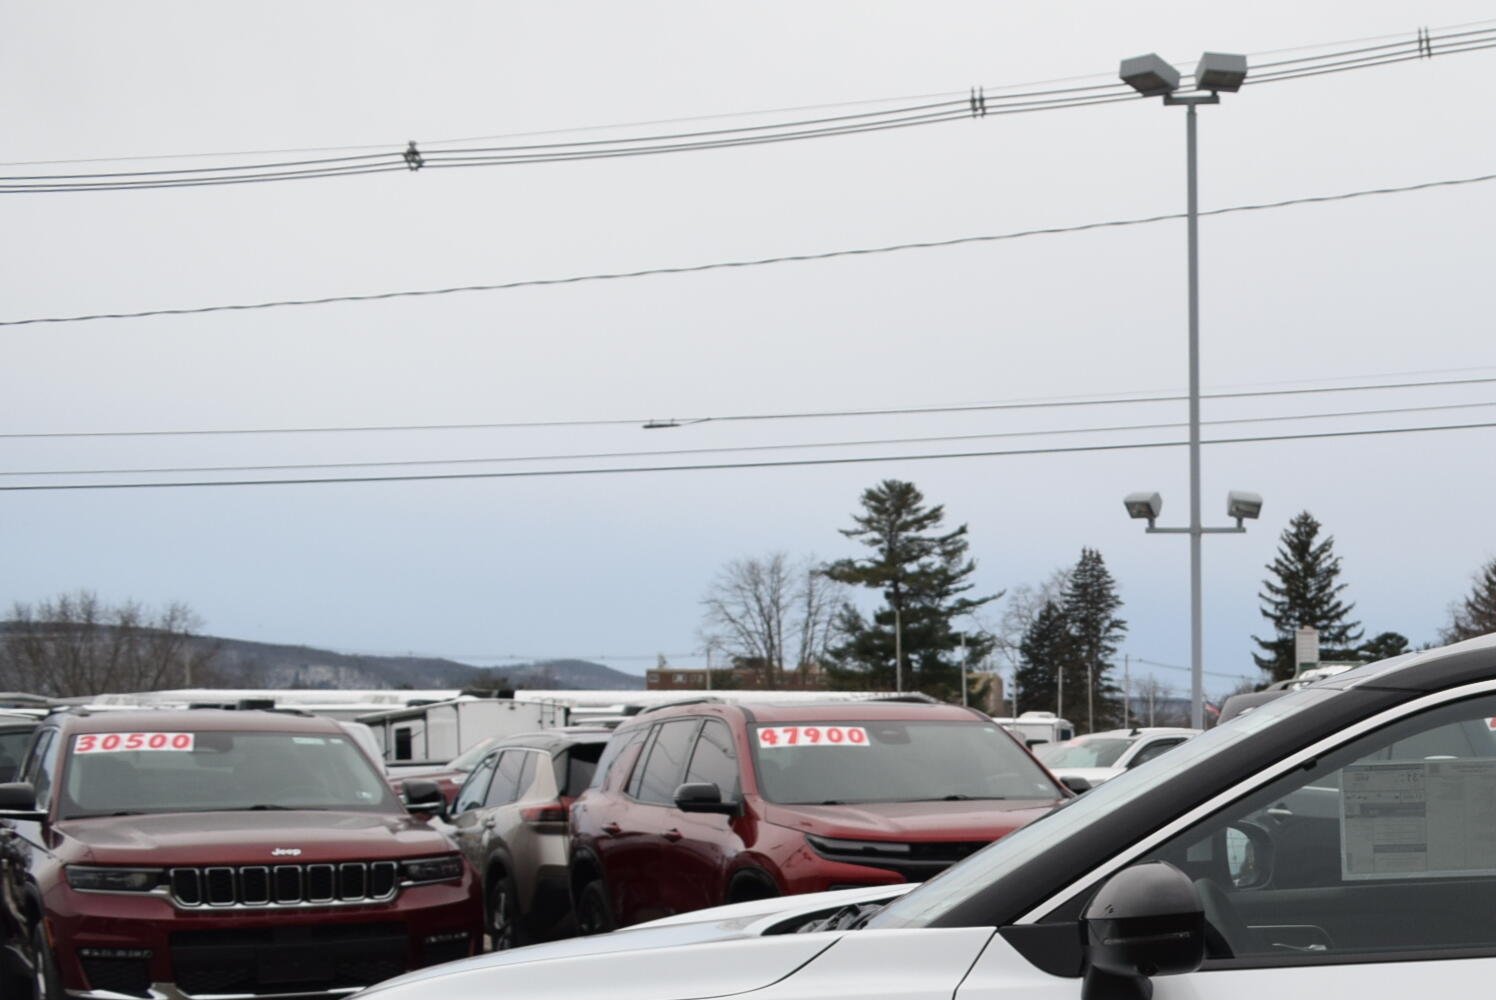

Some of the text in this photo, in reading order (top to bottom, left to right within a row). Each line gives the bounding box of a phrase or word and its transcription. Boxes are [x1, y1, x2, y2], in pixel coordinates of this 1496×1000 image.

[76, 733, 191, 752] 30500
[760, 727, 864, 745] 47900
[271, 847, 302, 857] Jeep
